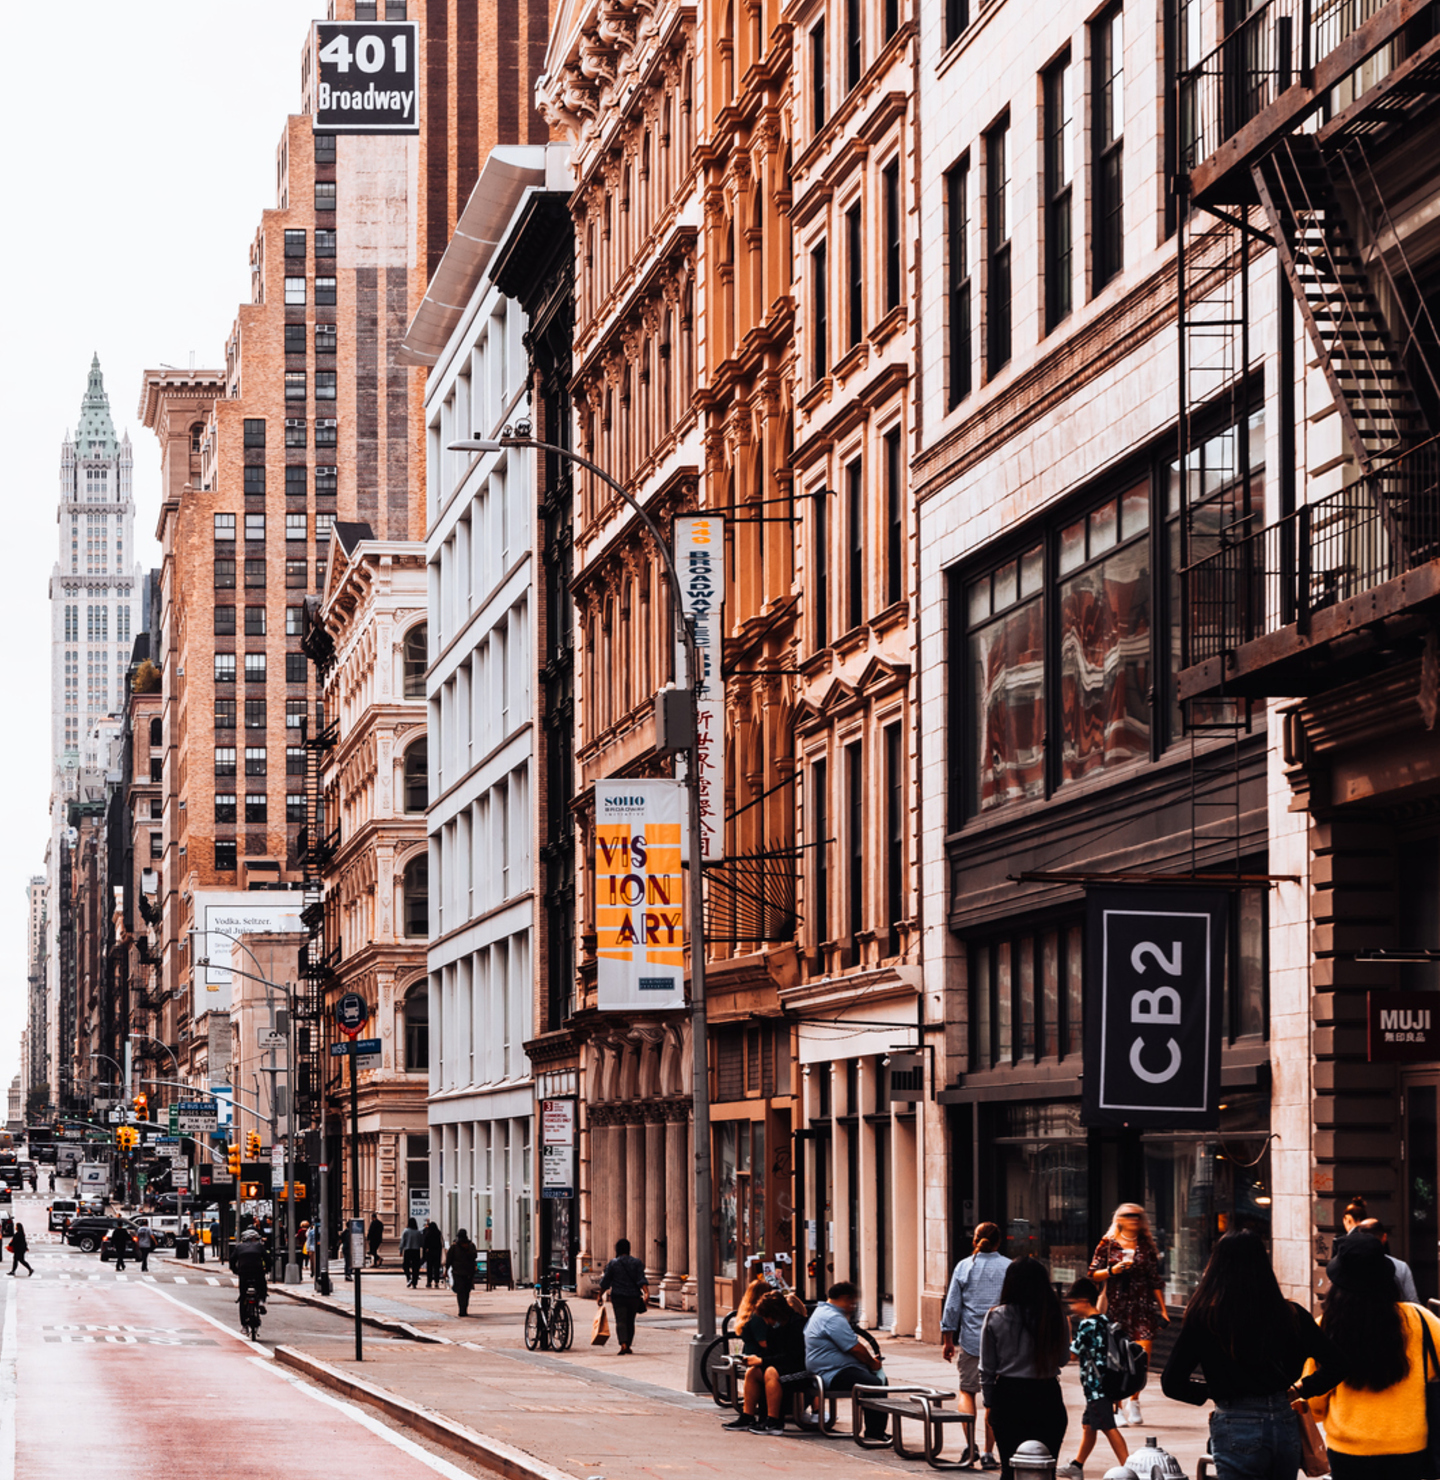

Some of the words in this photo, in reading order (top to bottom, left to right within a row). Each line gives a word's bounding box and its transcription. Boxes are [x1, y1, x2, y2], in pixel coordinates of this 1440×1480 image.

[318, 34, 407, 74] 401
[318, 82, 414, 118] Broadway
[686, 550, 715, 614] BROADWAY
[604, 796, 645, 807] SOHO
[598, 834, 648, 869] VIS
[609, 873, 671, 907] ION
[214, 917, 242, 926] Vodka.
[243, 917, 272, 926] Seltzer.
[615, 912, 682, 945] ARY
[1128, 940, 1183, 1084] CB2
[1380, 1009, 1431, 1030] MUJI
[1384, 1031, 1426, 1042] 無印良品
